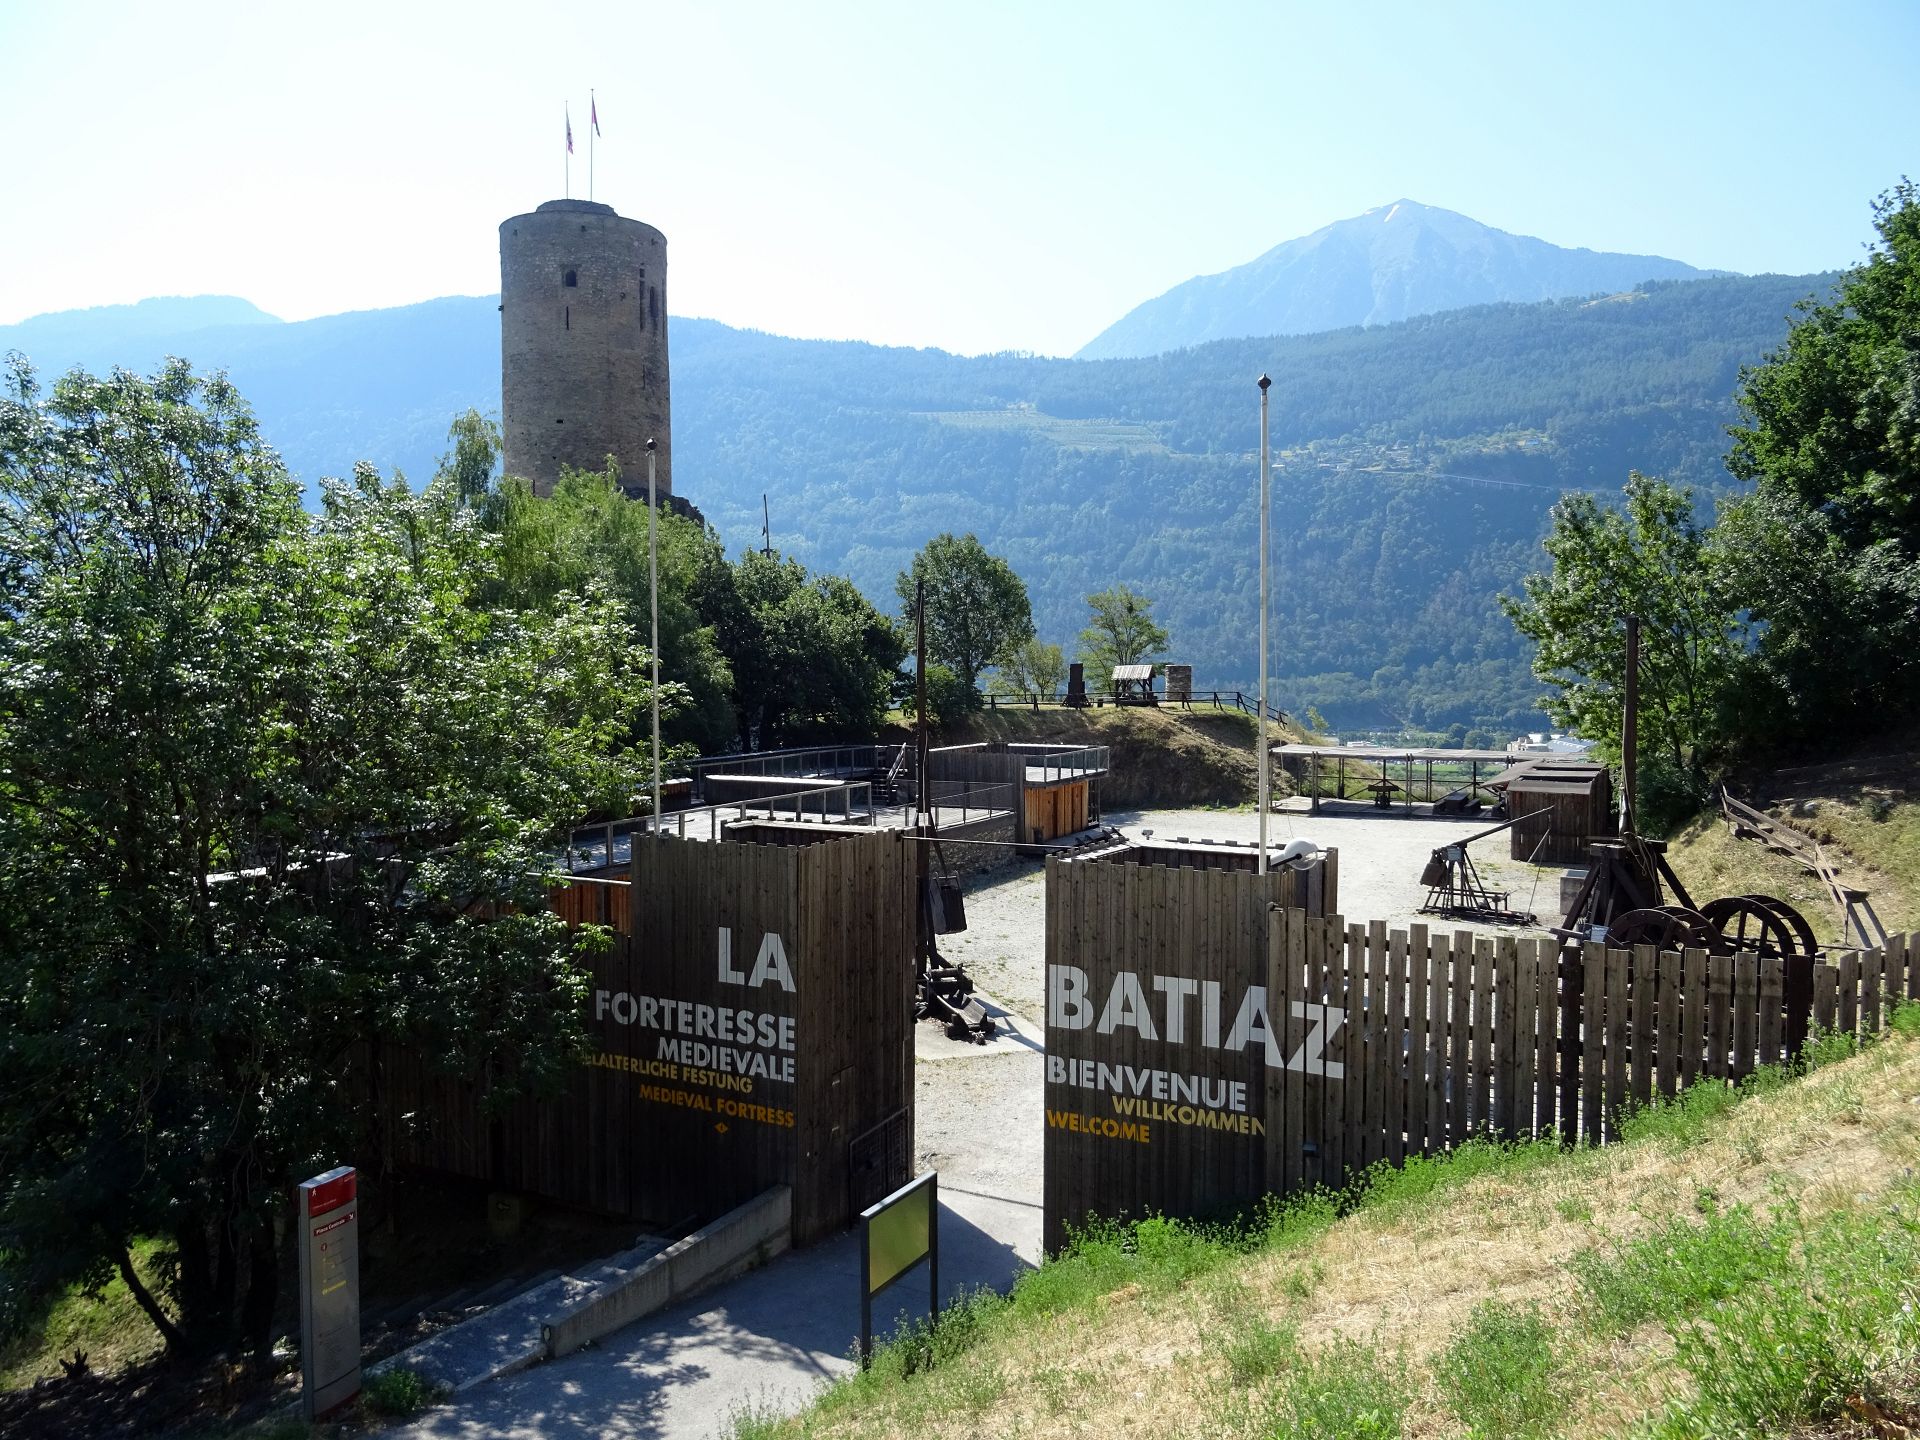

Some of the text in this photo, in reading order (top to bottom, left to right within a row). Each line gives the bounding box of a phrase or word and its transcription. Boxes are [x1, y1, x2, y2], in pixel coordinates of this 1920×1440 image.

[718, 926, 797, 993] LA
[595, 989, 796, 1051] FORTERESSE
[1048, 963, 1347, 1079] BATIAZ
[657, 1036, 795, 1083] MEDIEVALE
[683, 1066, 753, 1094] FESTUNG
[1047, 1054, 1247, 1112] BIENVENUE
[639, 1083, 796, 1128] MEDIEVAL FORTRESS
[1046, 1108, 1150, 1143] WELCOME
[1112, 1095, 1266, 1137] WILLKOMMEN
